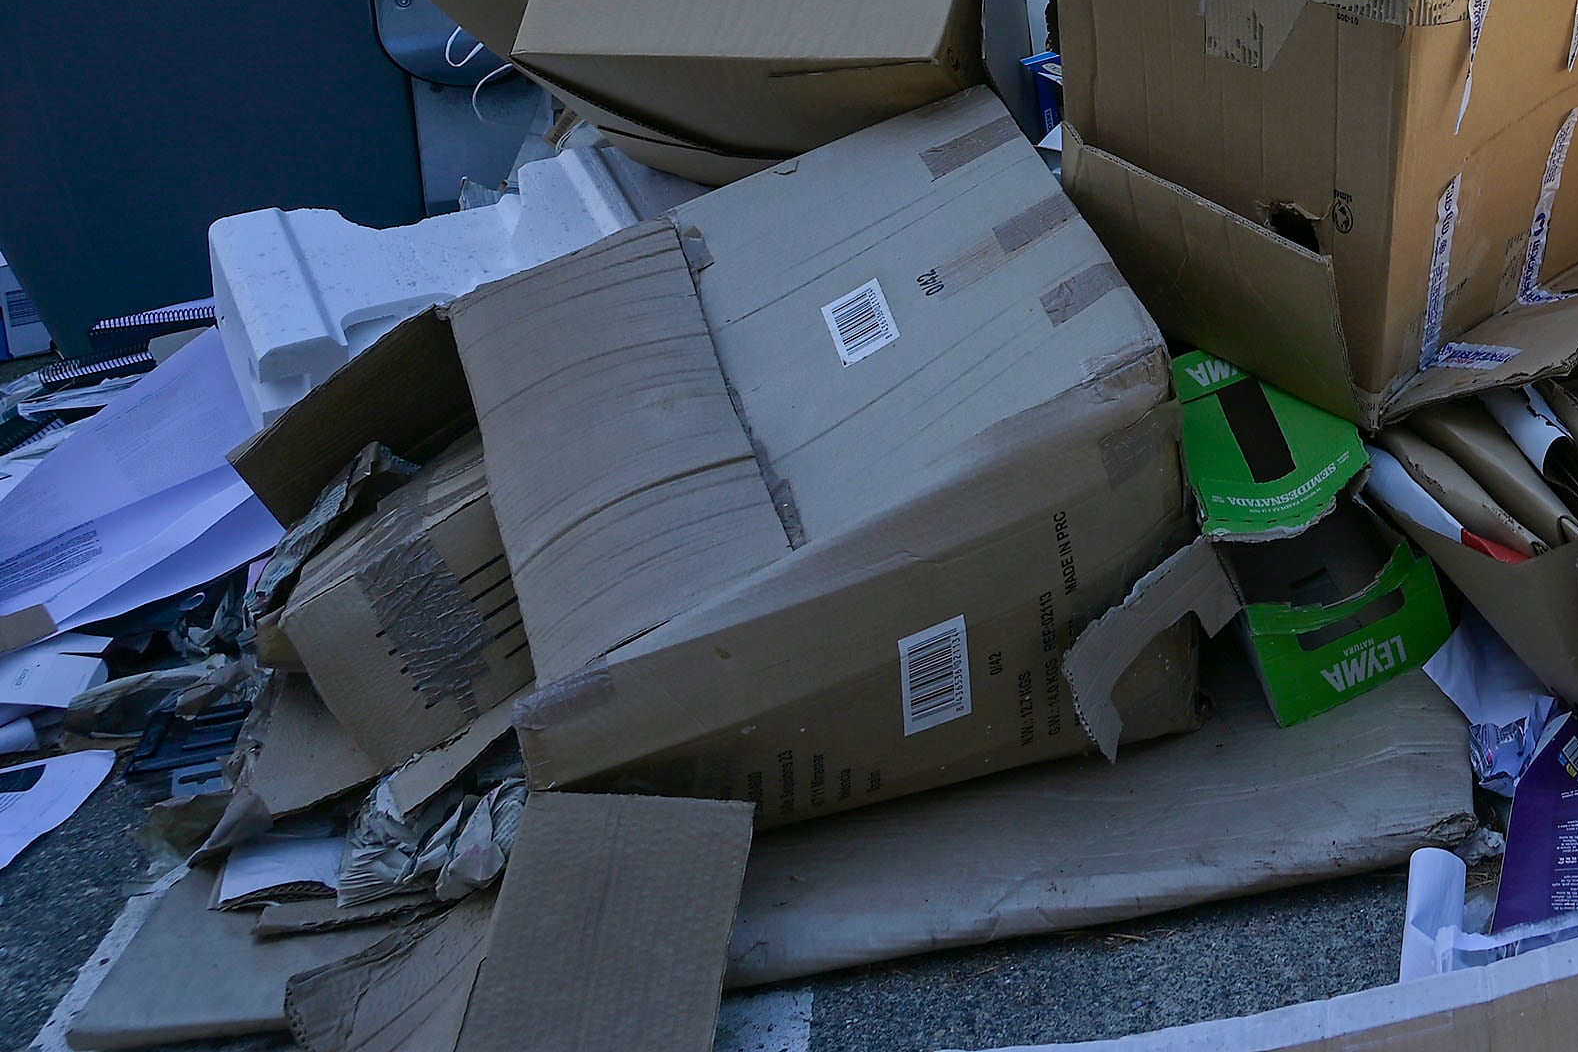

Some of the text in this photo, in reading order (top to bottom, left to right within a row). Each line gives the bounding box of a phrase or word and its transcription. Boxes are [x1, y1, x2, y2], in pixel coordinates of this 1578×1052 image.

[917, 268, 945, 296] 0/42
[1227, 462, 1337, 507] SEMIDESNATADA
[1053, 511, 1078, 596] MADE IN PRC
[1320, 635, 1408, 692] LEYMA
[1343, 637, 1375, 656] NATURA
